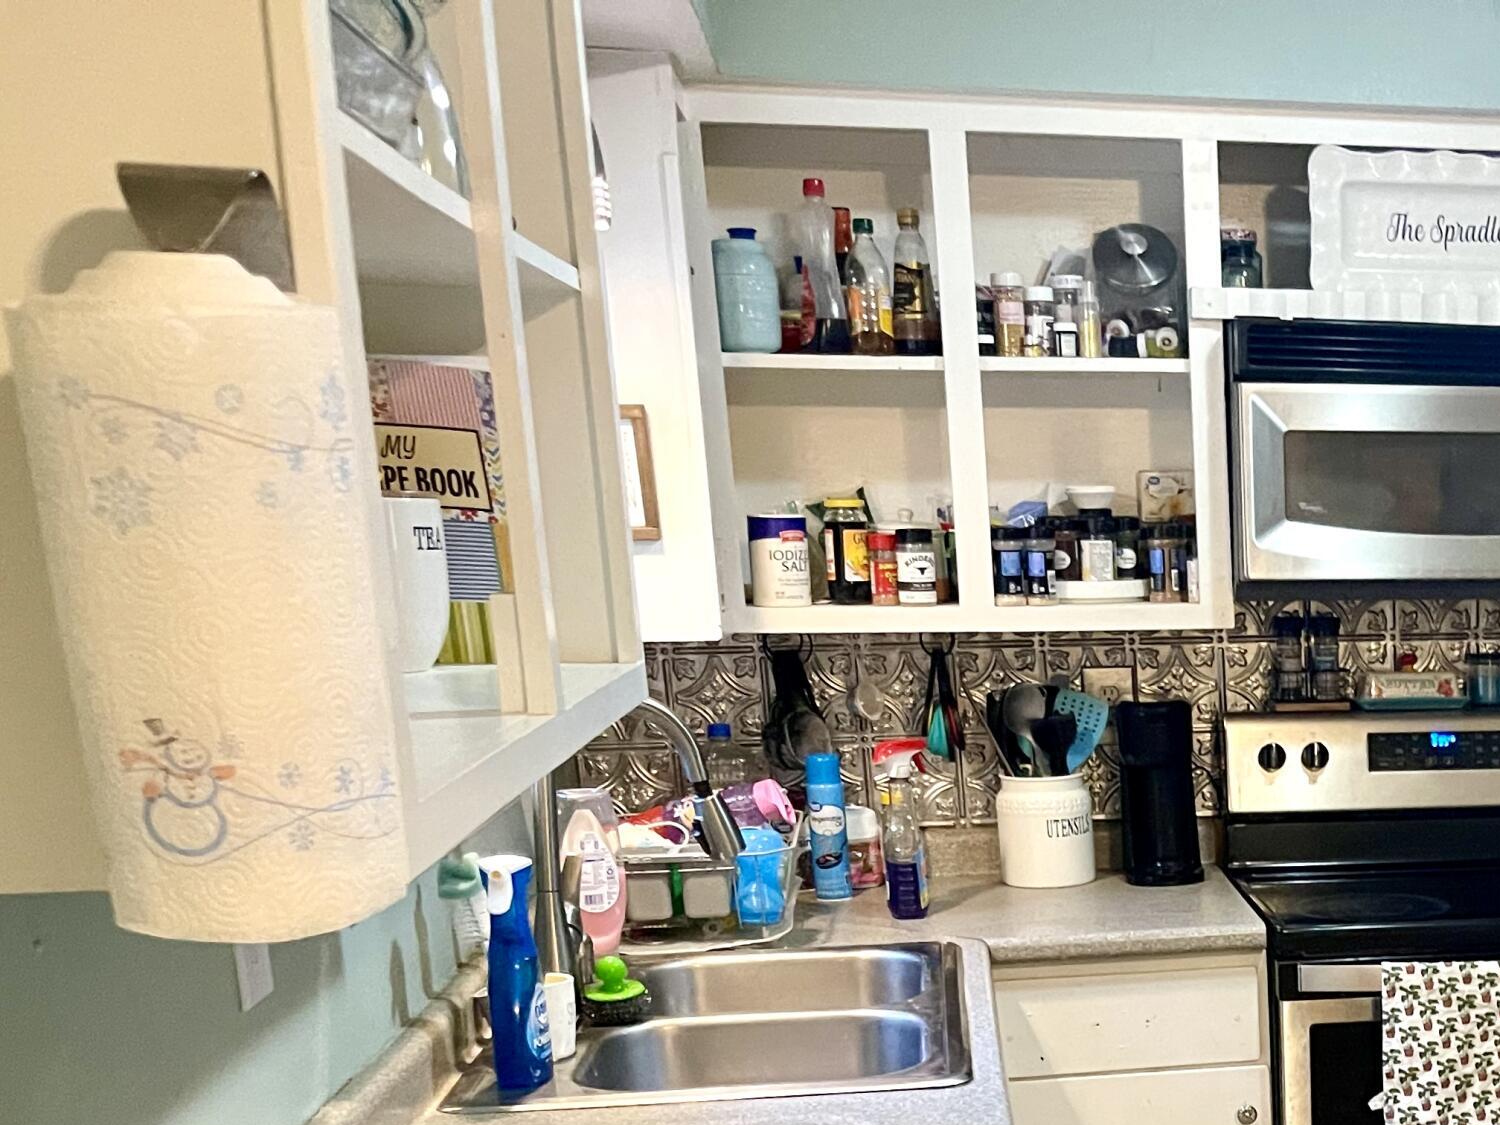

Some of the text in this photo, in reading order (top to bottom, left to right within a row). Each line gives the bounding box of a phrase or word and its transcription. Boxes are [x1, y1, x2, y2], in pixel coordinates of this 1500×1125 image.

[1386, 212, 1426, 243] The
[380, 434, 416, 460] MY
[379, 465, 480, 499] PE BOOK
